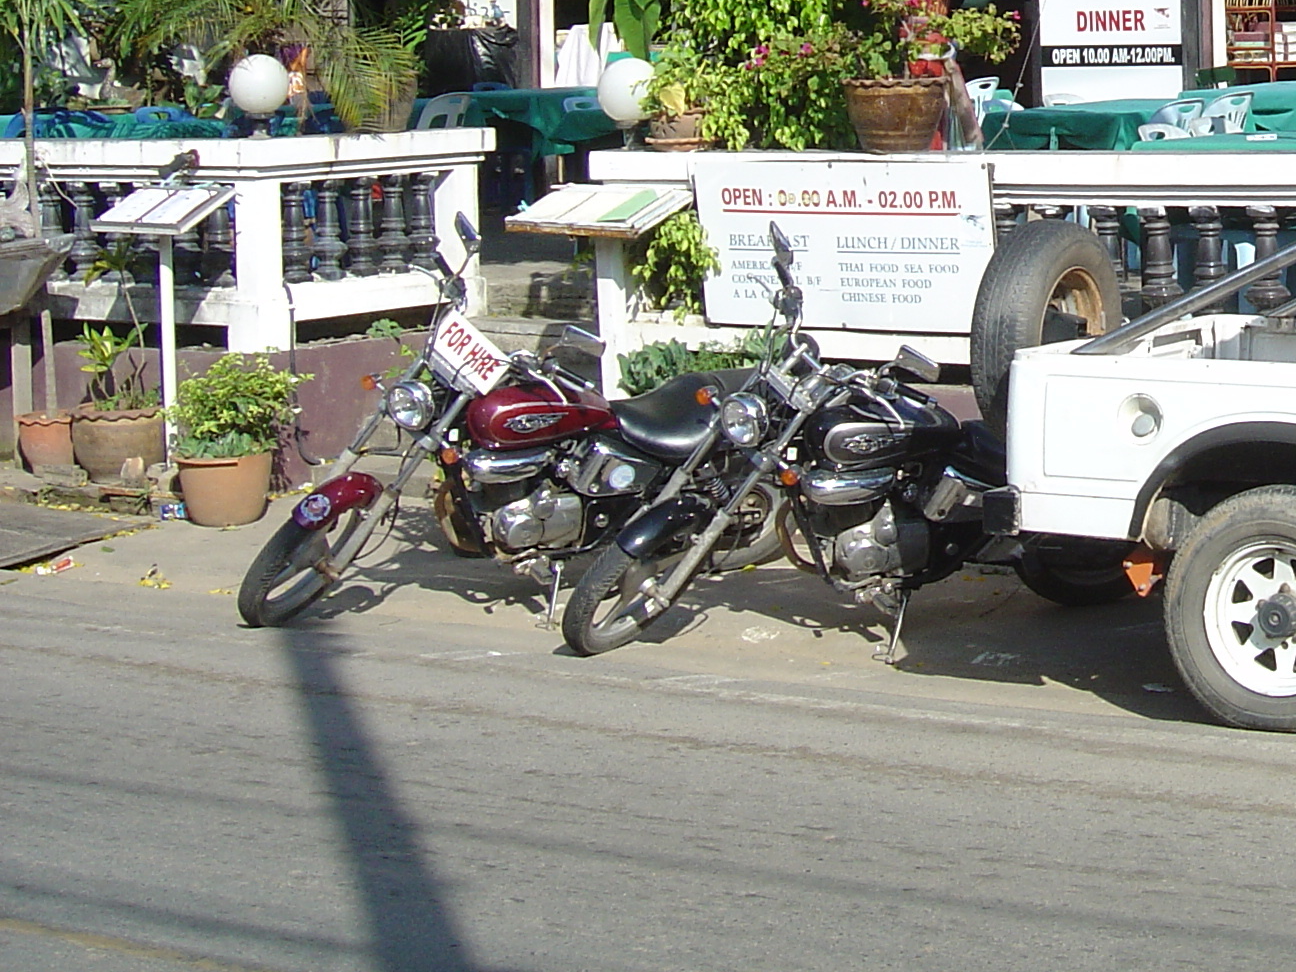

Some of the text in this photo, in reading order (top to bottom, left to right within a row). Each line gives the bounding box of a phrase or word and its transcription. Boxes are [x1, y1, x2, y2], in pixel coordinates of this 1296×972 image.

[1076, 10, 1145, 32] DINNER
[1052, 48, 1080, 64] OPEN
[1083, 47, 1110, 64] 10.00
[721, 187, 763, 206] OPEN
[826, 190, 862, 208] A.M.
[878, 190, 923, 209] 02.00
[929, 191, 962, 209] P.M.
[729, 234, 809, 247] BREAST
[836, 236, 888, 249] LUNCH
[901, 237, 960, 250] DINNER
[731, 260, 776, 270] AMERIC
[838, 263, 959, 274] THAI FOOD SEA FOOD
[732, 274, 802, 285] COTINEL
[840, 277, 932, 289] EUROPEAN FOOD
[744, 289, 757, 299] LA
[841, 292, 922, 304] CHINESE FOOD
[440, 322, 500, 381] FOR HIRE
